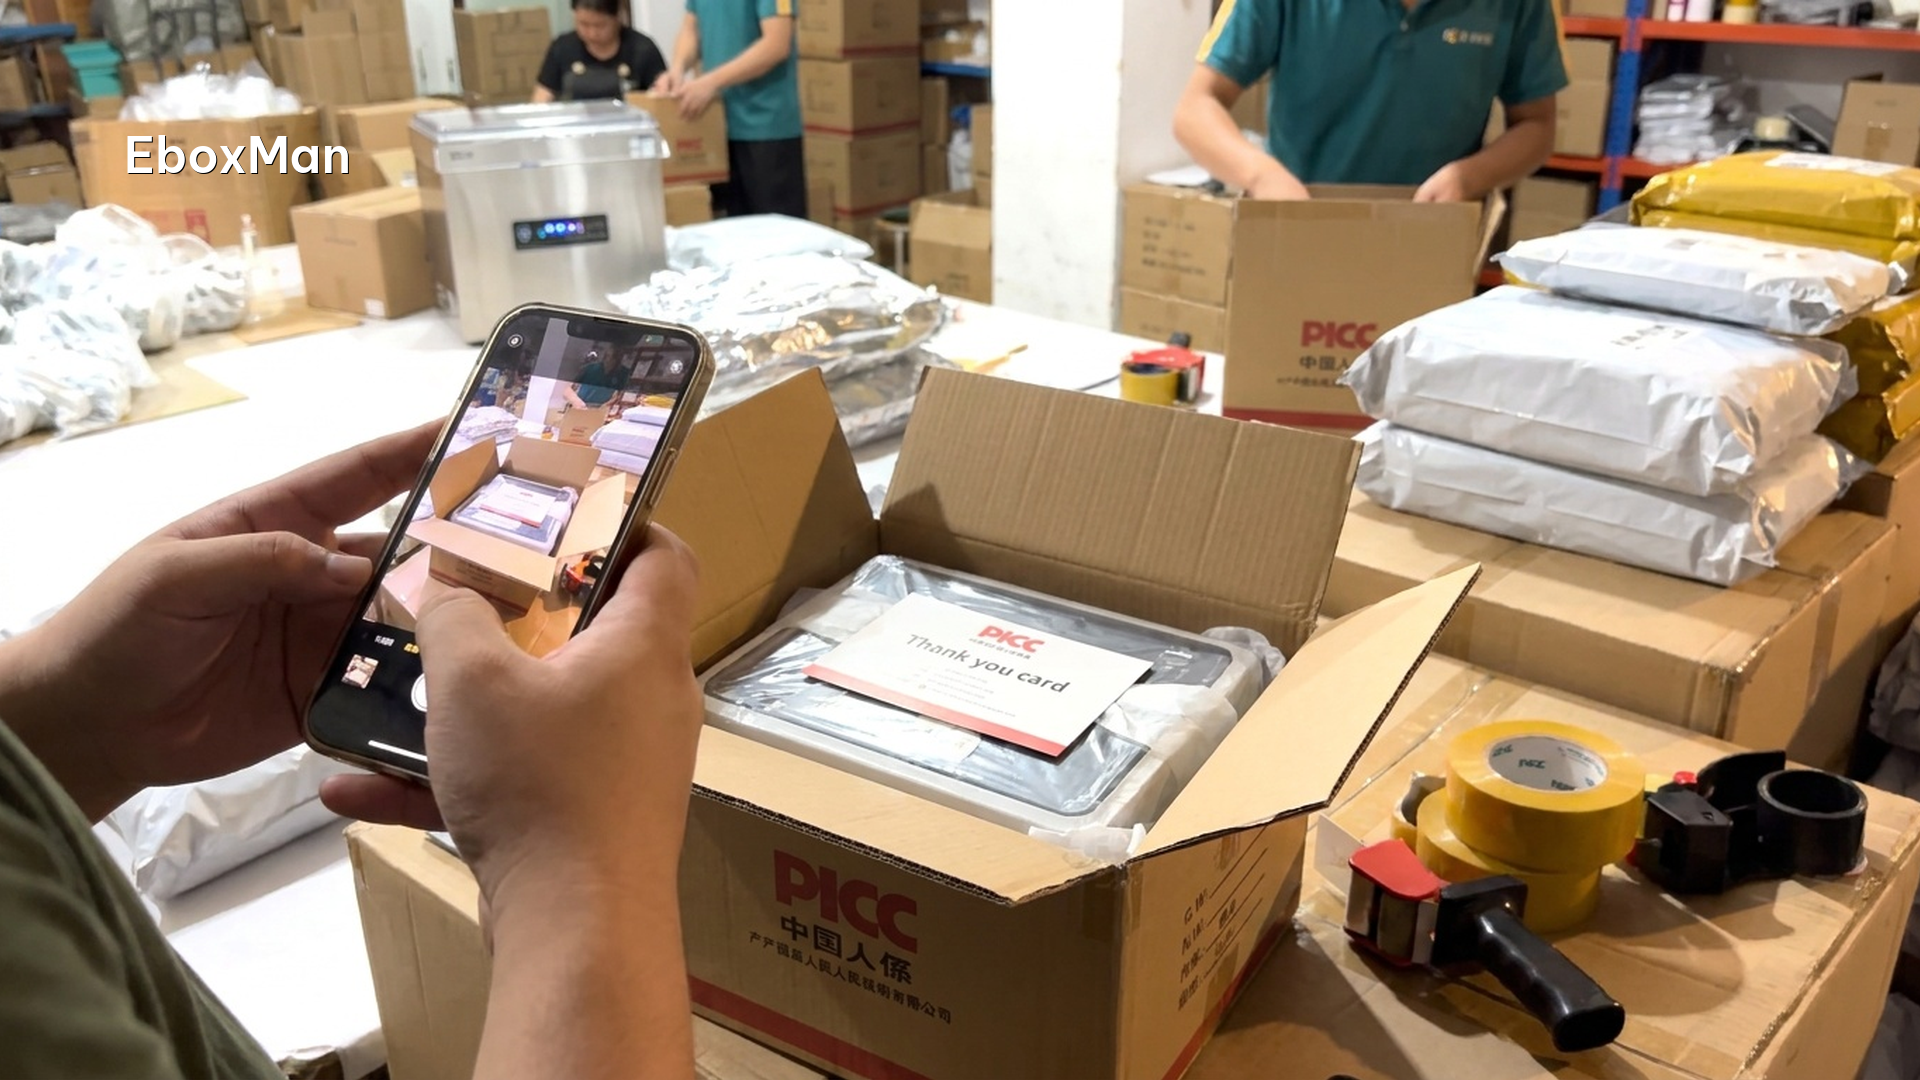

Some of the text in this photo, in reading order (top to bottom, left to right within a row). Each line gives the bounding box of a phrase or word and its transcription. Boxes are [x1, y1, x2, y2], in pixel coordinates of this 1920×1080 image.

[1301, 321, 1377, 350] PICC
[977, 625, 1045, 653] PICC
[906, 634, 970, 663] Thank
[968, 658, 1014, 676] you
[1016, 671, 1071, 693] card
[774, 849, 918, 955] PICC
